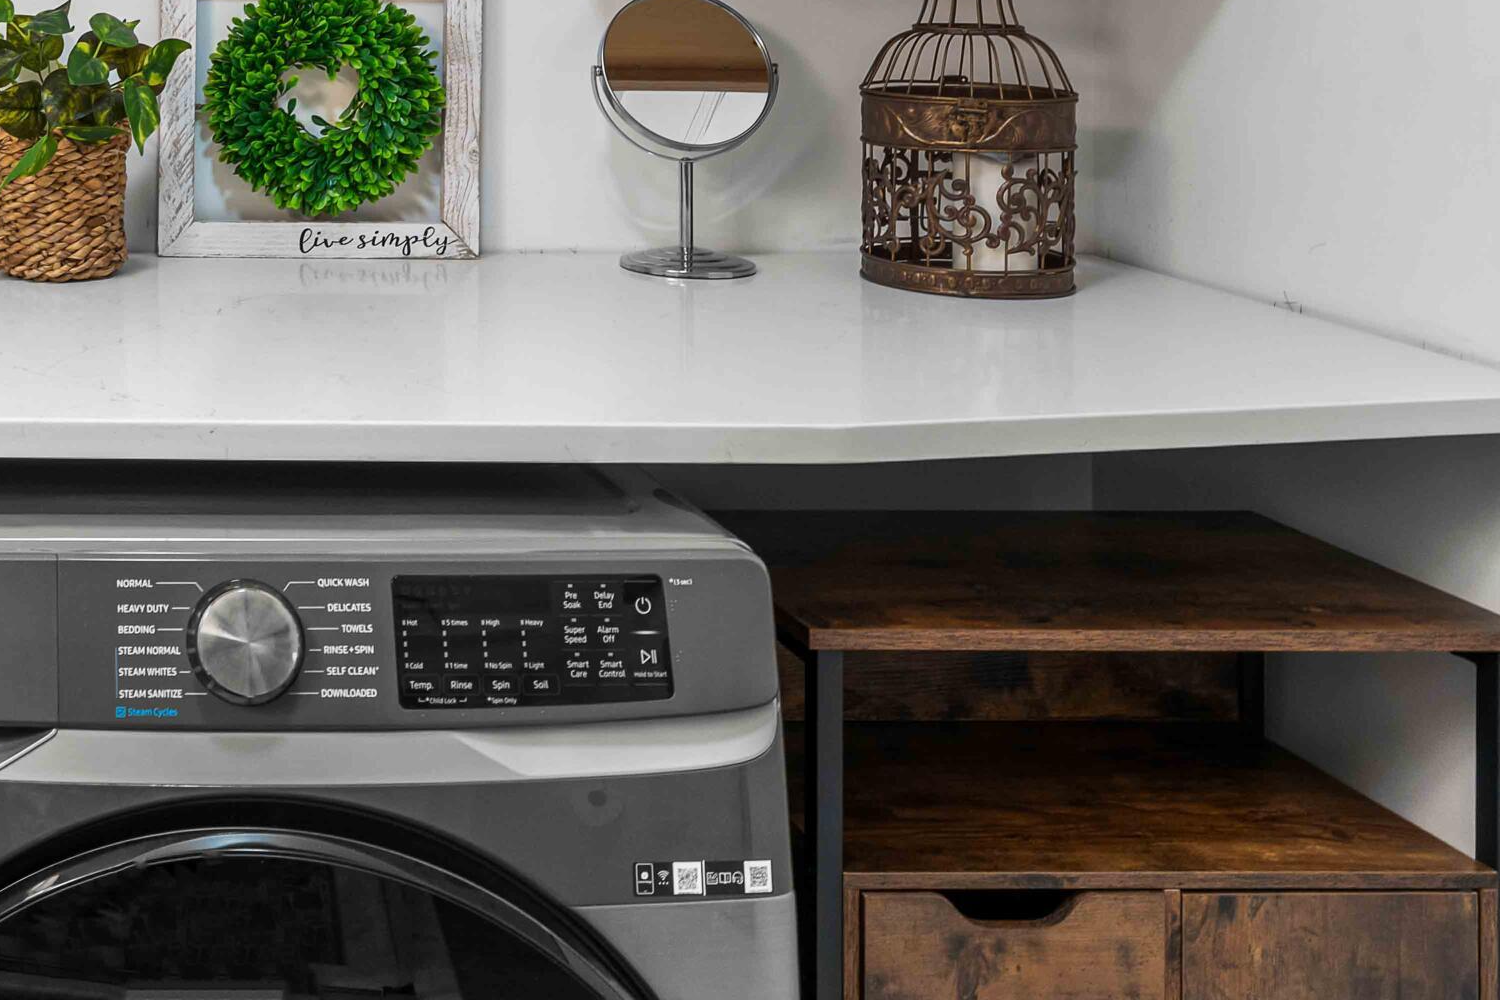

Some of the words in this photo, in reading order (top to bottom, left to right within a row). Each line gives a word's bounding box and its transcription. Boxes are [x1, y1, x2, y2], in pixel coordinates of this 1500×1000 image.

[299, 227, 354, 255] live
[356, 226, 460, 257] simply
[116, 579, 153, 588] NORMAL
[317, 578, 343, 588] QUICK
[344, 578, 370, 587] WASH
[565, 591, 578, 600] Pre
[593, 591, 615, 602] Delay
[117, 603, 145, 613] HEAVY
[146, 603, 170, 613] DUTY
[327, 603, 372, 613] DELICATES
[563, 601, 582, 609] Soak
[598, 601, 613, 609] End
[524, 619, 544, 627] Heavy
[118, 624, 157, 635] BEDDING
[340, 623, 374, 634] TOWELS
[564, 626, 586, 635] Super
[597, 626, 619, 634] Alarm
[563, 635, 588, 645] Speed
[602, 635, 616, 643] Off
[118, 645, 145, 656] STEAM
[146, 645, 182, 656] NORMAL
[409, 662, 424, 670] Cold
[566, 660, 590, 669] Smart
[600, 660, 623, 669] Smart
[118, 666, 146, 677] STEAM
[146, 666, 178, 677] WHITES
[326, 666, 347, 676] SELF
[570, 669, 588, 678] Care
[598, 669, 626, 678] Control
[409, 680, 434, 691] Temp.
[450, 680, 473, 690] Rinse
[492, 680, 510, 691] Spin
[533, 680, 549, 690] Soil
[119, 689, 147, 699] STEAM
[147, 689, 183, 699] SANITIZE
[320, 688, 378, 699] DOWNLOADED
